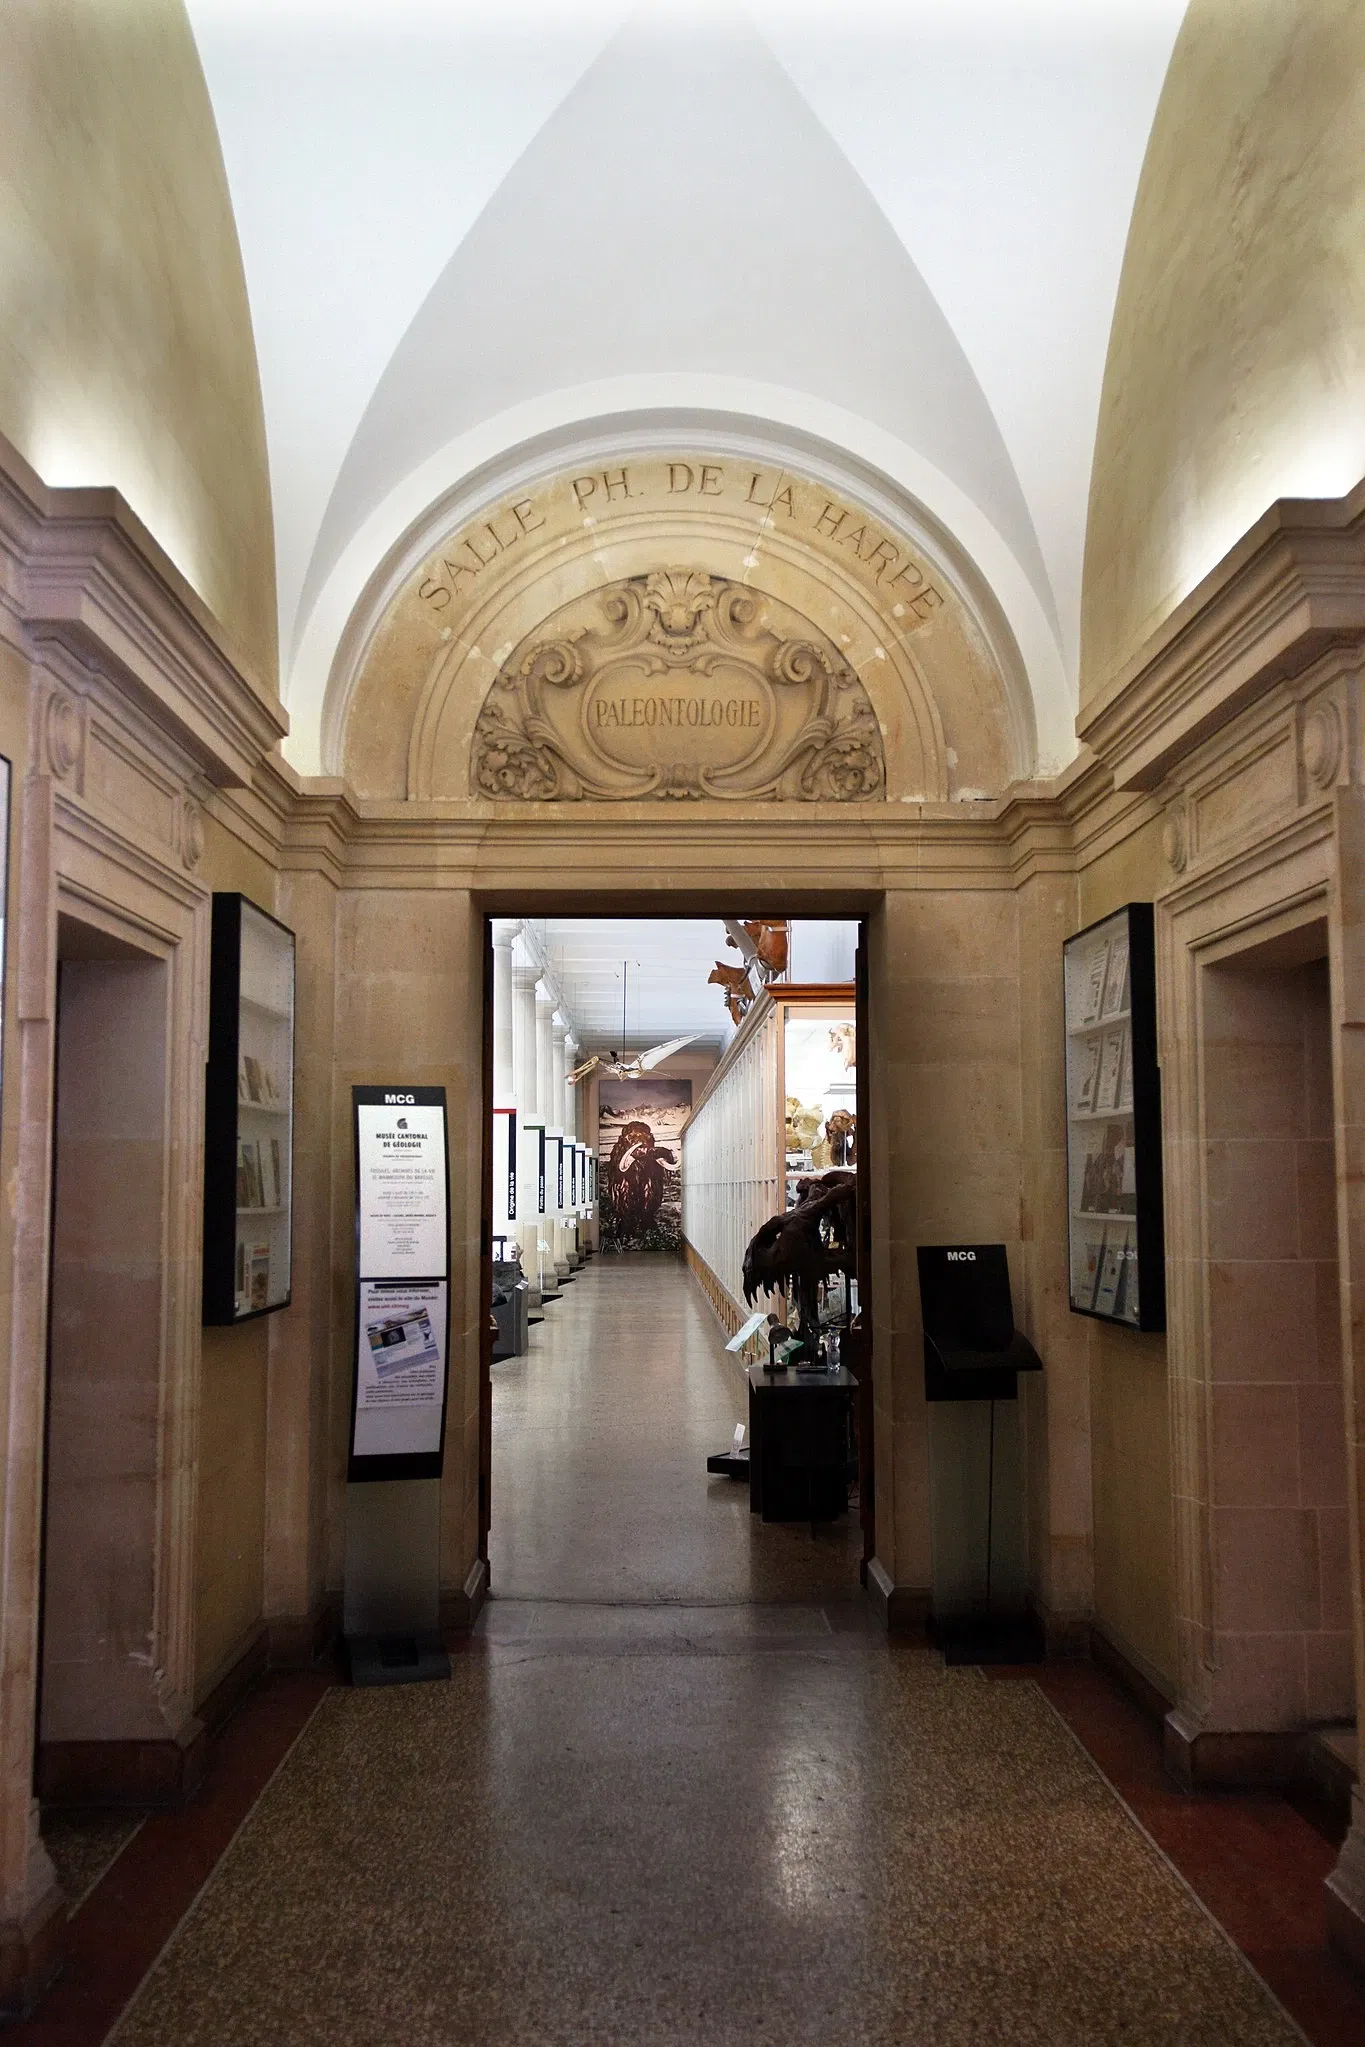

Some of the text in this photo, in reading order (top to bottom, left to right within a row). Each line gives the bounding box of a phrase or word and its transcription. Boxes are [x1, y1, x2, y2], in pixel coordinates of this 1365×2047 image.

[418, 463, 944, 620] SALLE PH. DE LA HARPE
[595, 698, 761, 728] PALEONTOLOGIE
[384, 1094, 415, 1104] MCG
[508, 1195, 516, 1215] Origine
[947, 1251, 977, 1261] MCG
